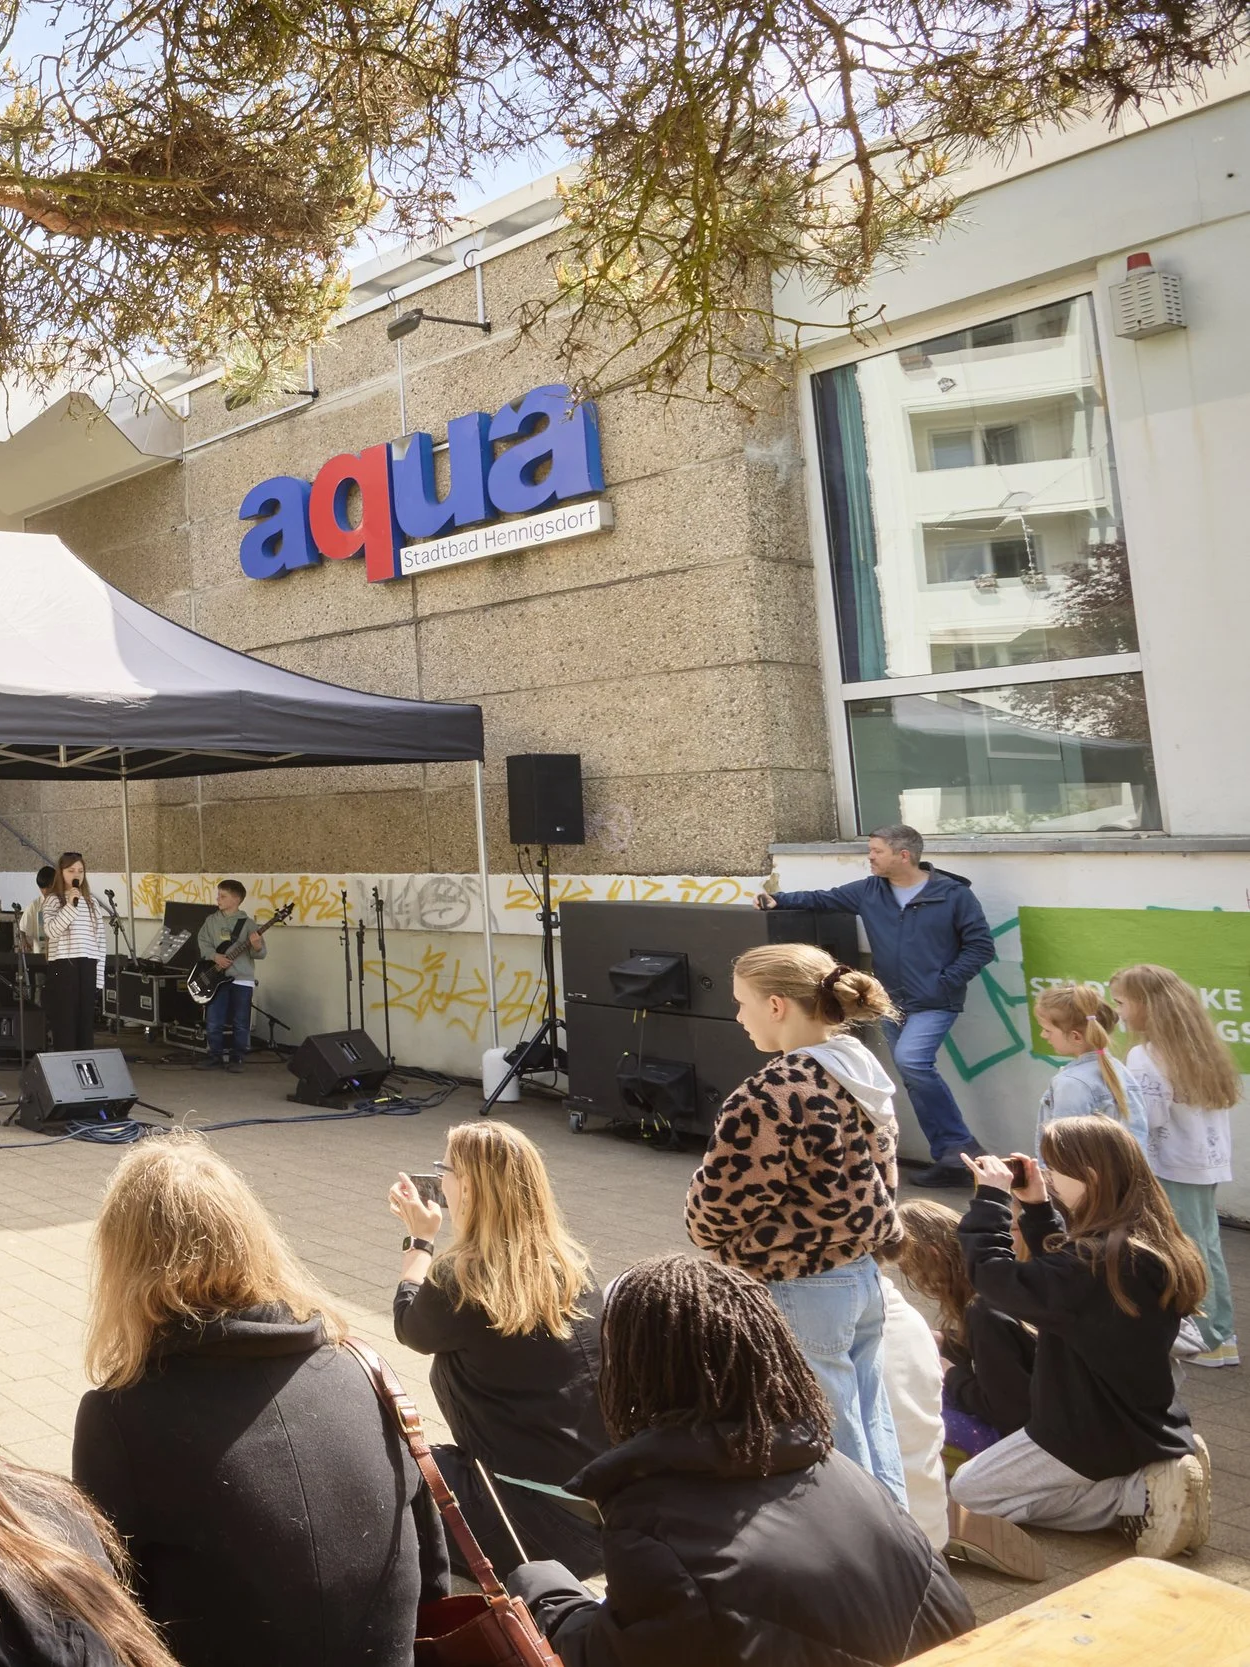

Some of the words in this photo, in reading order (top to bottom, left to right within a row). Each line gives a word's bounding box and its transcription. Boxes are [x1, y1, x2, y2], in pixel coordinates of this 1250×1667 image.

[239, 383, 605, 583] aqua
[403, 534, 479, 568] Stadtbad
[484, 504, 597, 549] Hennigsdorf
